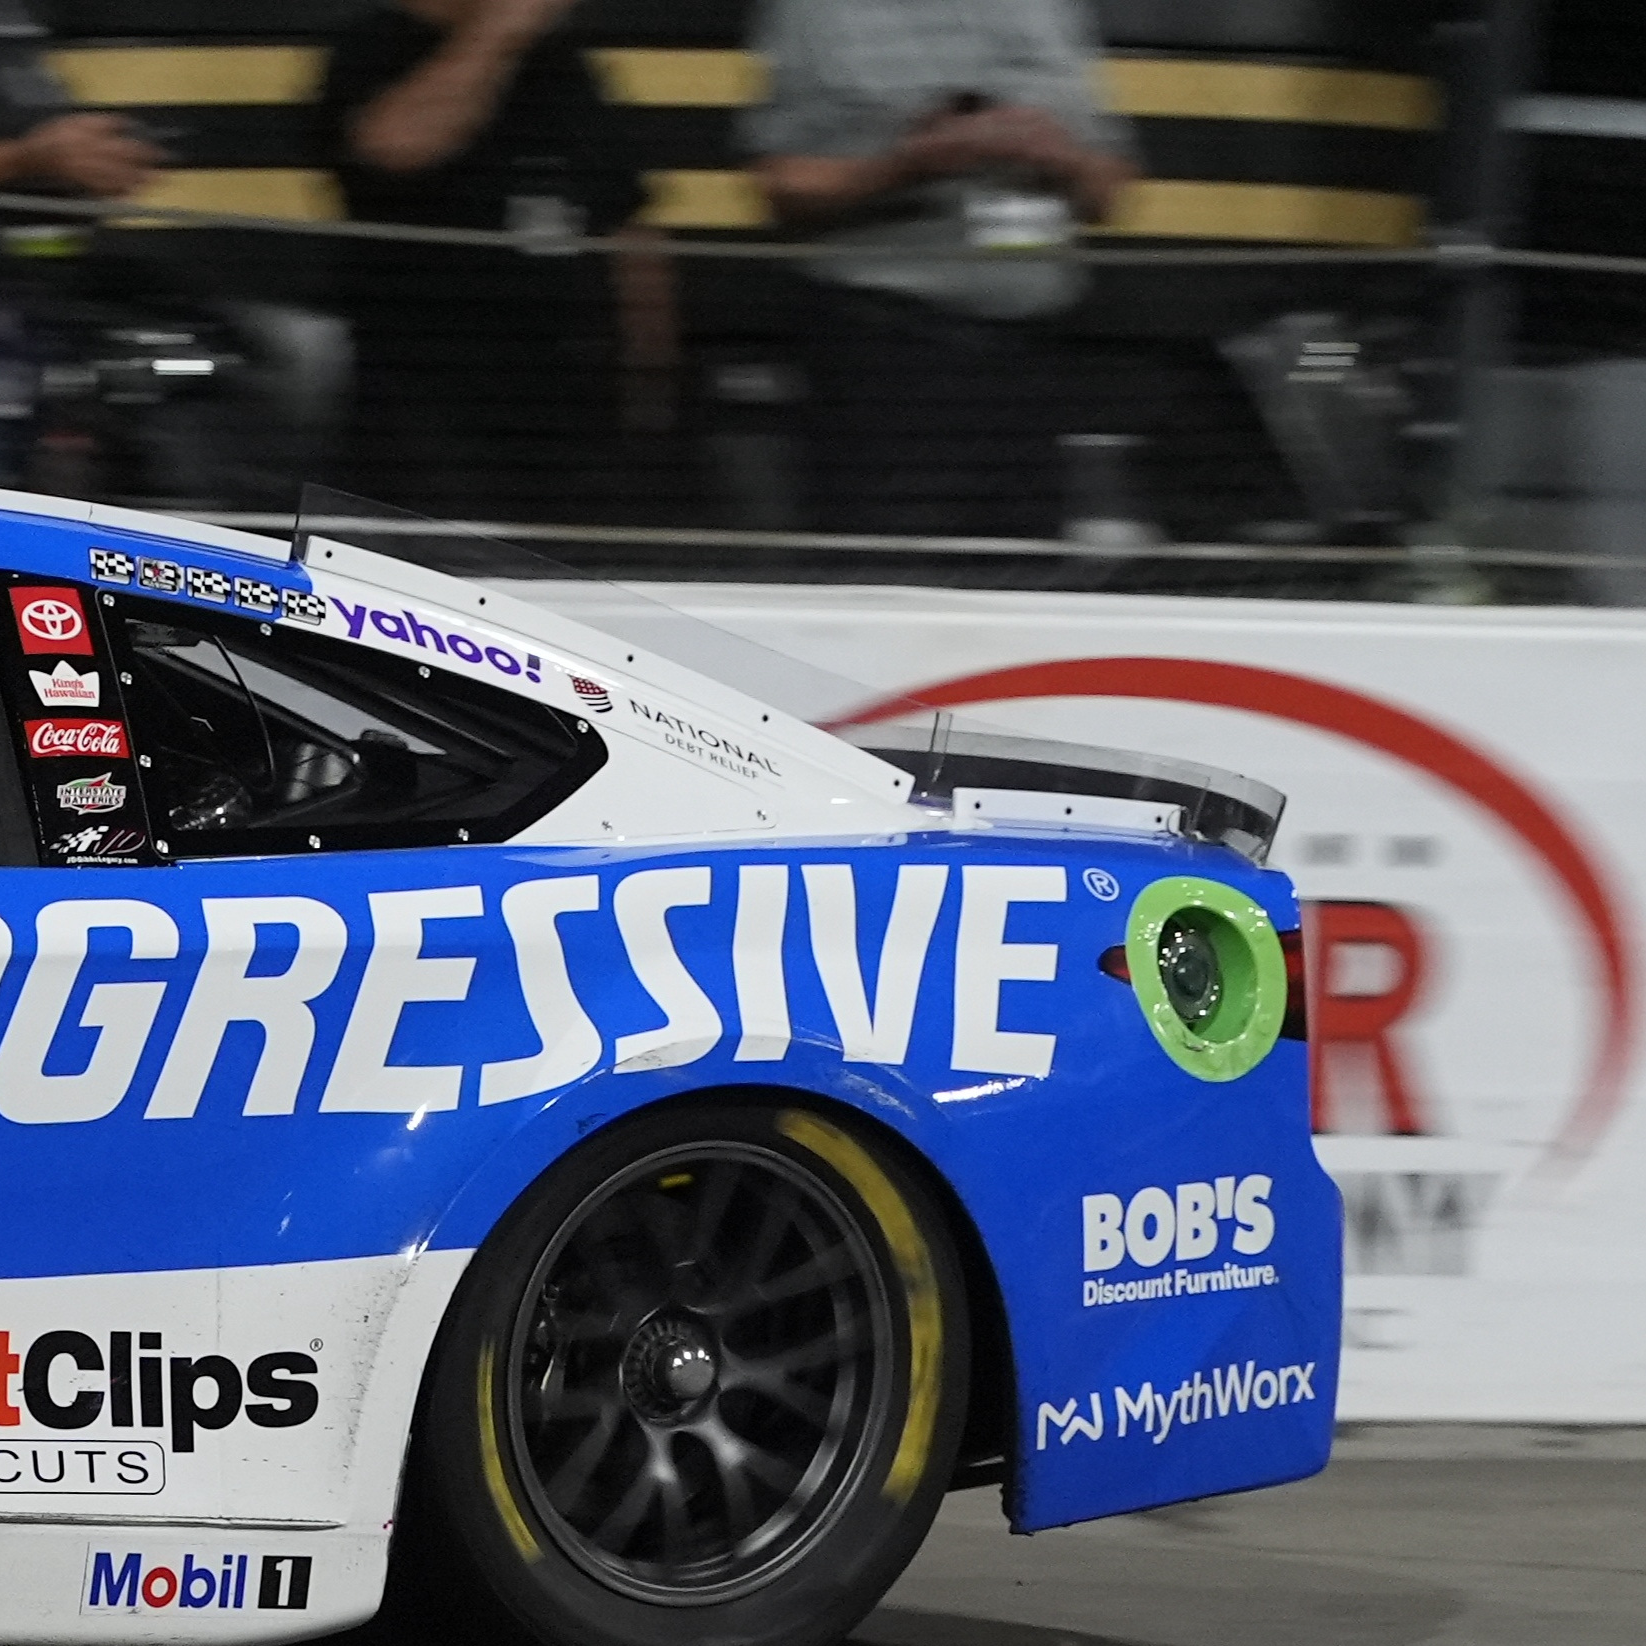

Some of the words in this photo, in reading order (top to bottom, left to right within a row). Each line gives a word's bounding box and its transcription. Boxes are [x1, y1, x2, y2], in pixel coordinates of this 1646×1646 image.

[327, 595, 542, 685] yahoo!
[629, 699, 782, 777] NATIONAL
[664, 733, 703, 757] DEBT
[710, 753, 760, 780] RELIEF
[1082, 1174, 1275, 1272] BOB'S
[1083, 1273, 1172, 1307] Discount
[1114, 1360, 1317, 1445] MythWorx
[88, 1551, 249, 1611] Mobil
